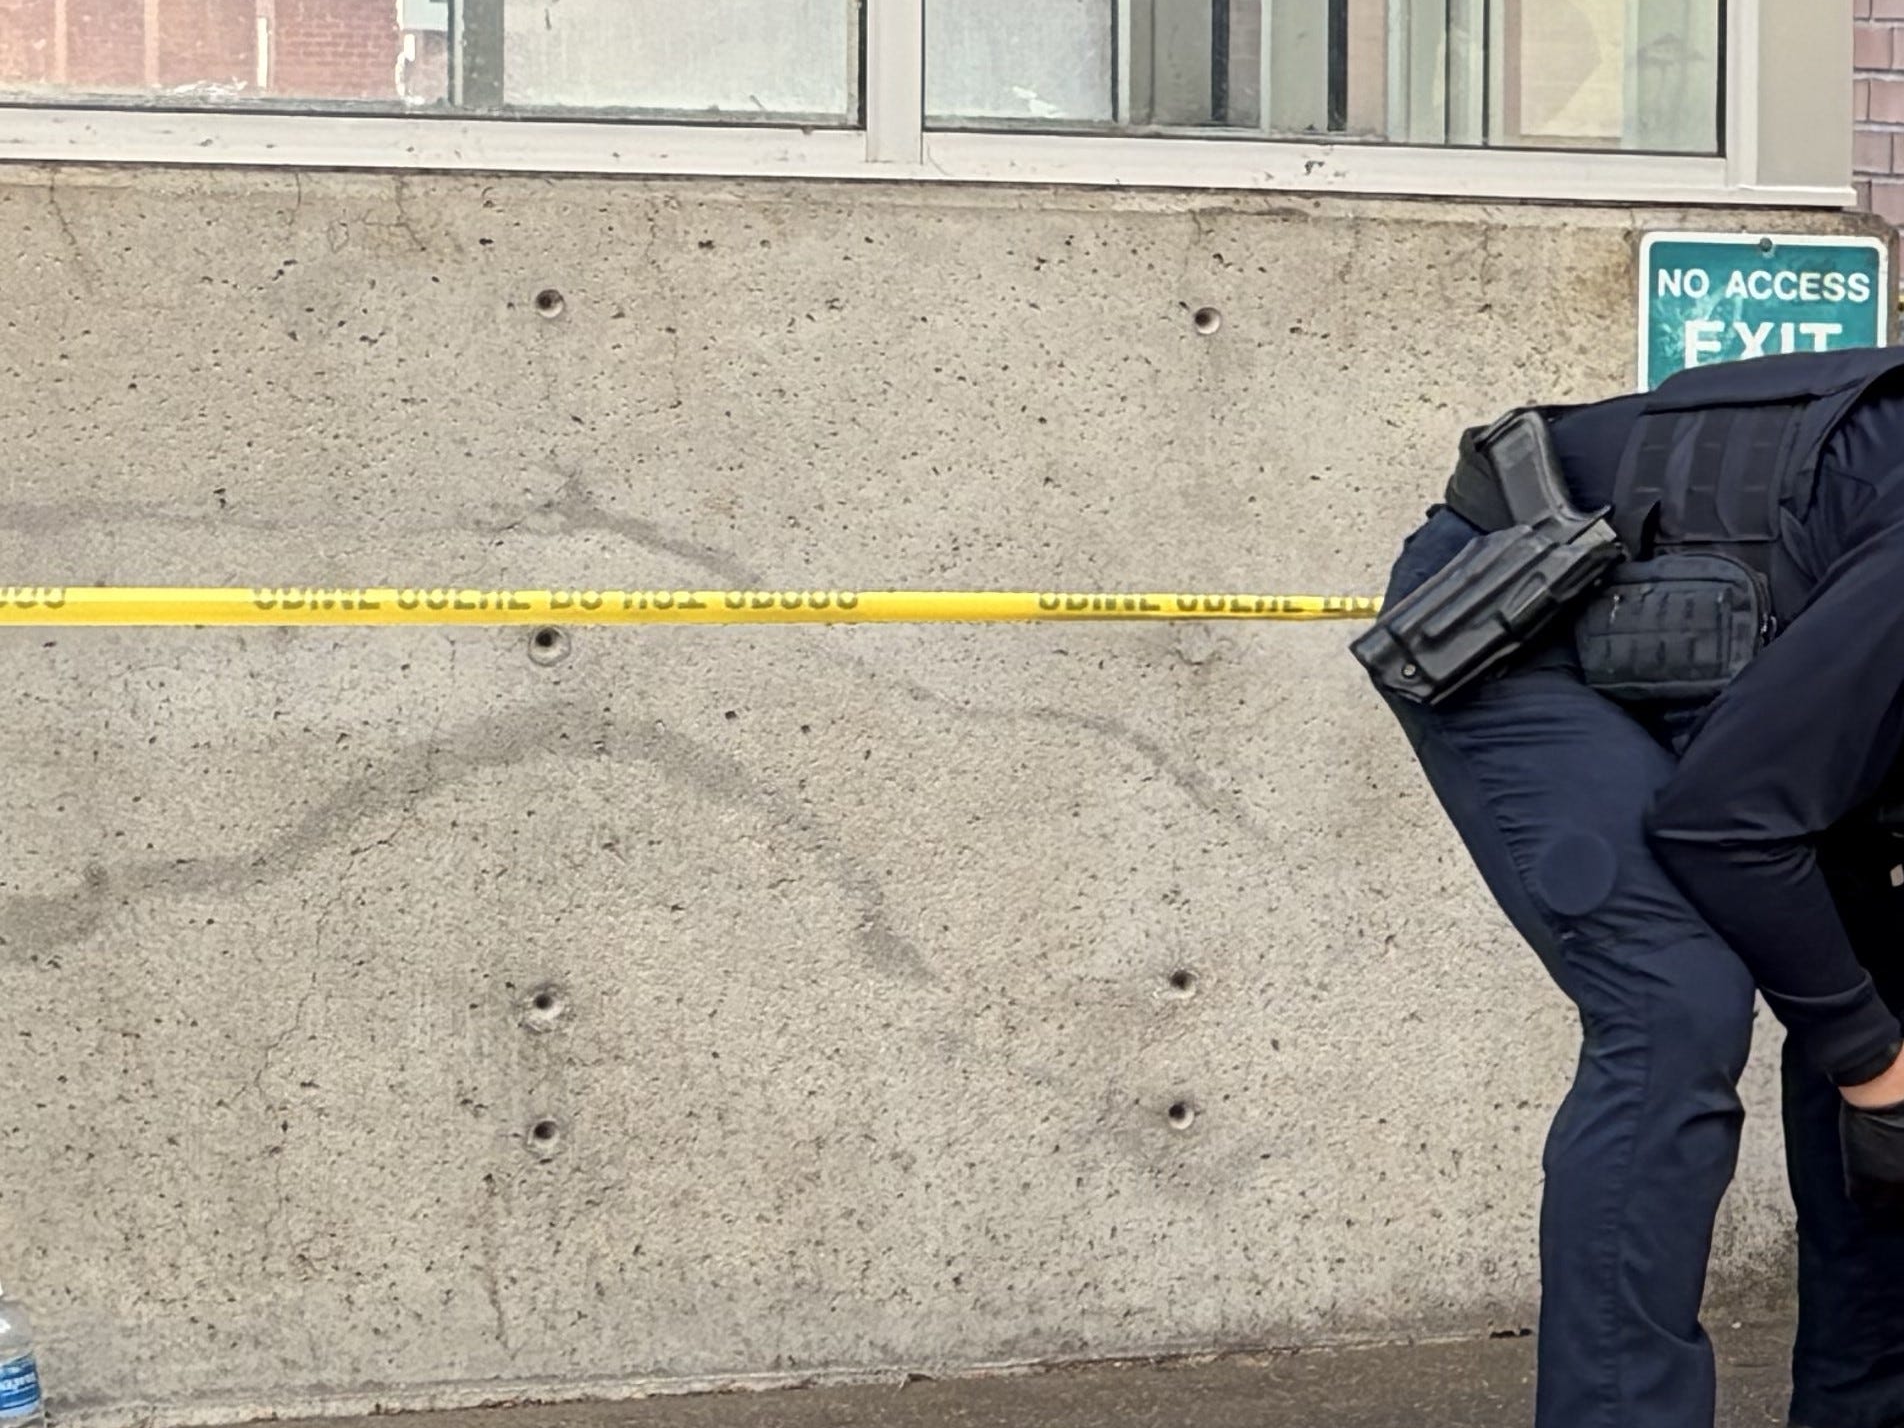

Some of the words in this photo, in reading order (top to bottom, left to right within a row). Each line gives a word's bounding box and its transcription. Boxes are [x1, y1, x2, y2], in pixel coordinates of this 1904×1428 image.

[1657, 268, 1710, 298] NO
[1724, 269, 1871, 303] ACCESS
[1683, 320, 1843, 369] EXIT
